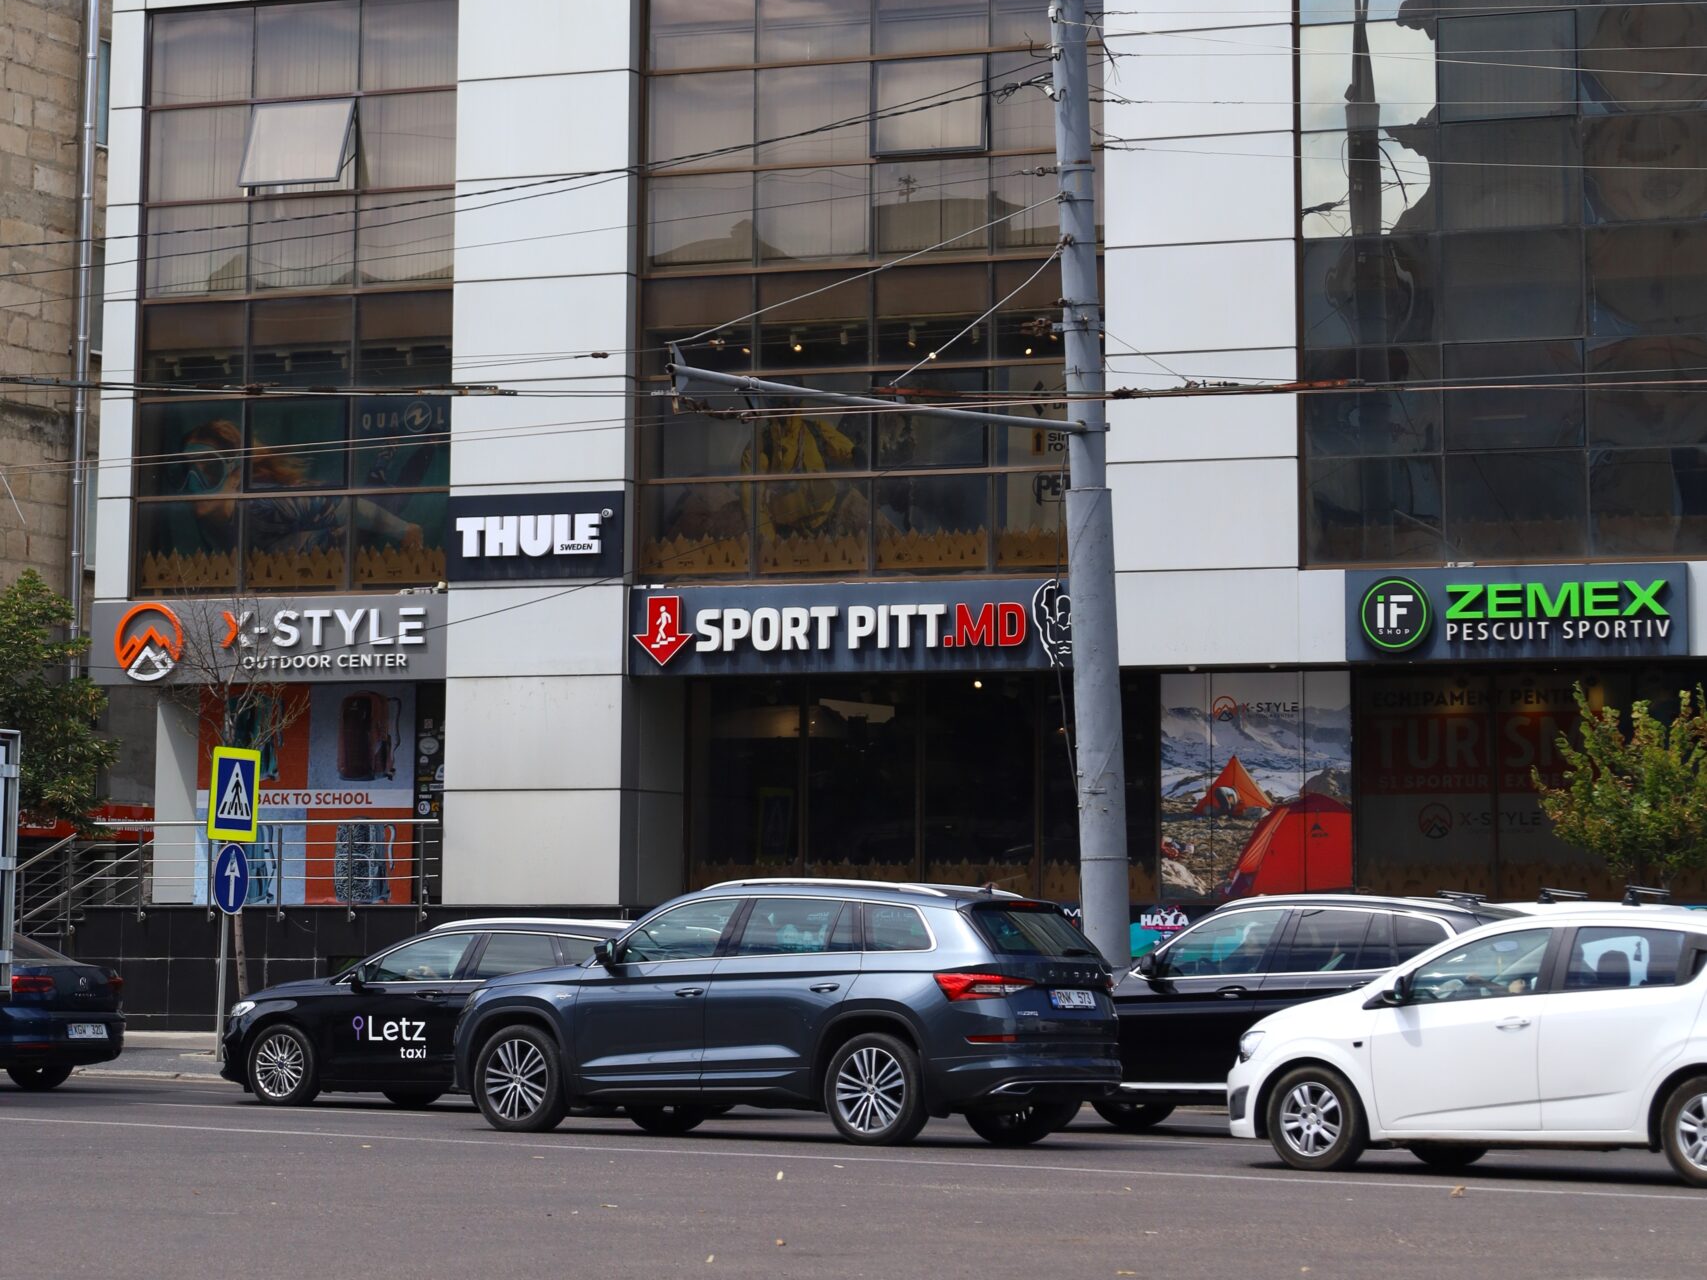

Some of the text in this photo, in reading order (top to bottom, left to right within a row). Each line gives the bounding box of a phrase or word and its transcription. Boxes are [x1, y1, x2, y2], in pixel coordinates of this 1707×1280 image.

[456, 513, 601, 558] THULE
[560, 543, 593, 551] SWEDEN
[1445, 579, 1670, 619] ZEMEX
[219, 607, 426, 648] X-STYLE
[695, 606, 839, 652] SPORT
[1446, 619, 1670, 641] PESCUIT SPORTIV
[243, 653, 408, 669] OUTDOOR CENTER
[293, 793, 312, 805] TO
[315, 792, 372, 805] SCHOOL
[368, 1015, 426, 1041] Letz
[400, 1045, 426, 1059] taxi
